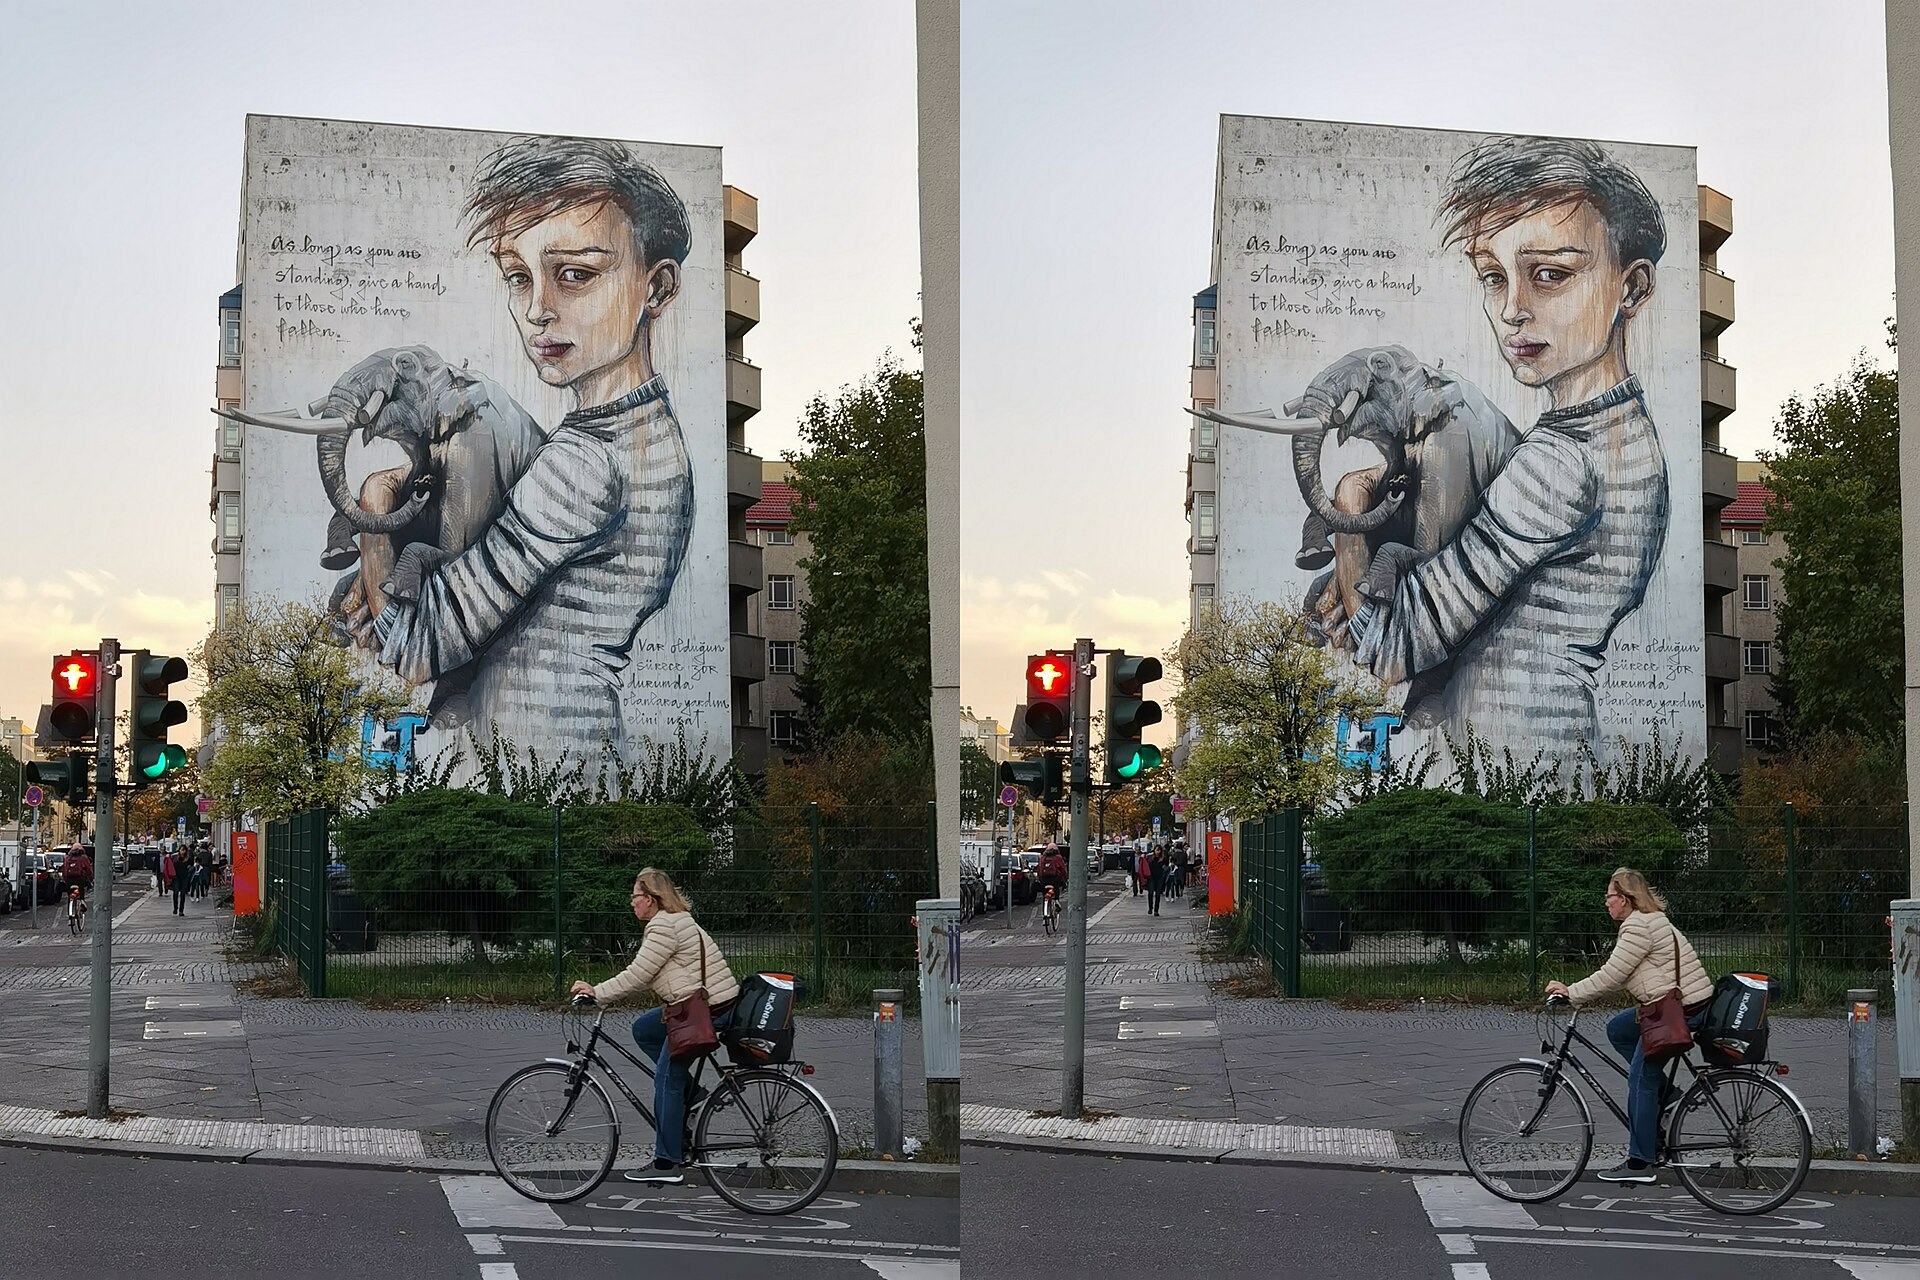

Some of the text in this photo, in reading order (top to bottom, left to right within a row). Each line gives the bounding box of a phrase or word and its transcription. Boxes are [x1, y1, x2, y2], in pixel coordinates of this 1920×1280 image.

[300, 235, 341, 266] long
[344, 244, 362, 255] as
[365, 247, 394, 267] you
[1275, 235, 1316, 266] long
[1319, 244, 1337, 255] as
[1340, 247, 1369, 267] you
[357, 276, 388, 300] give
[391, 279, 402, 288] a
[405, 271, 446, 295] hand
[1332, 276, 1363, 300] give
[1366, 279, 1377, 288] a
[1380, 271, 1421, 295] hand
[274, 293, 410, 319] to those who have
[1249, 293, 1385, 319] to those who have
